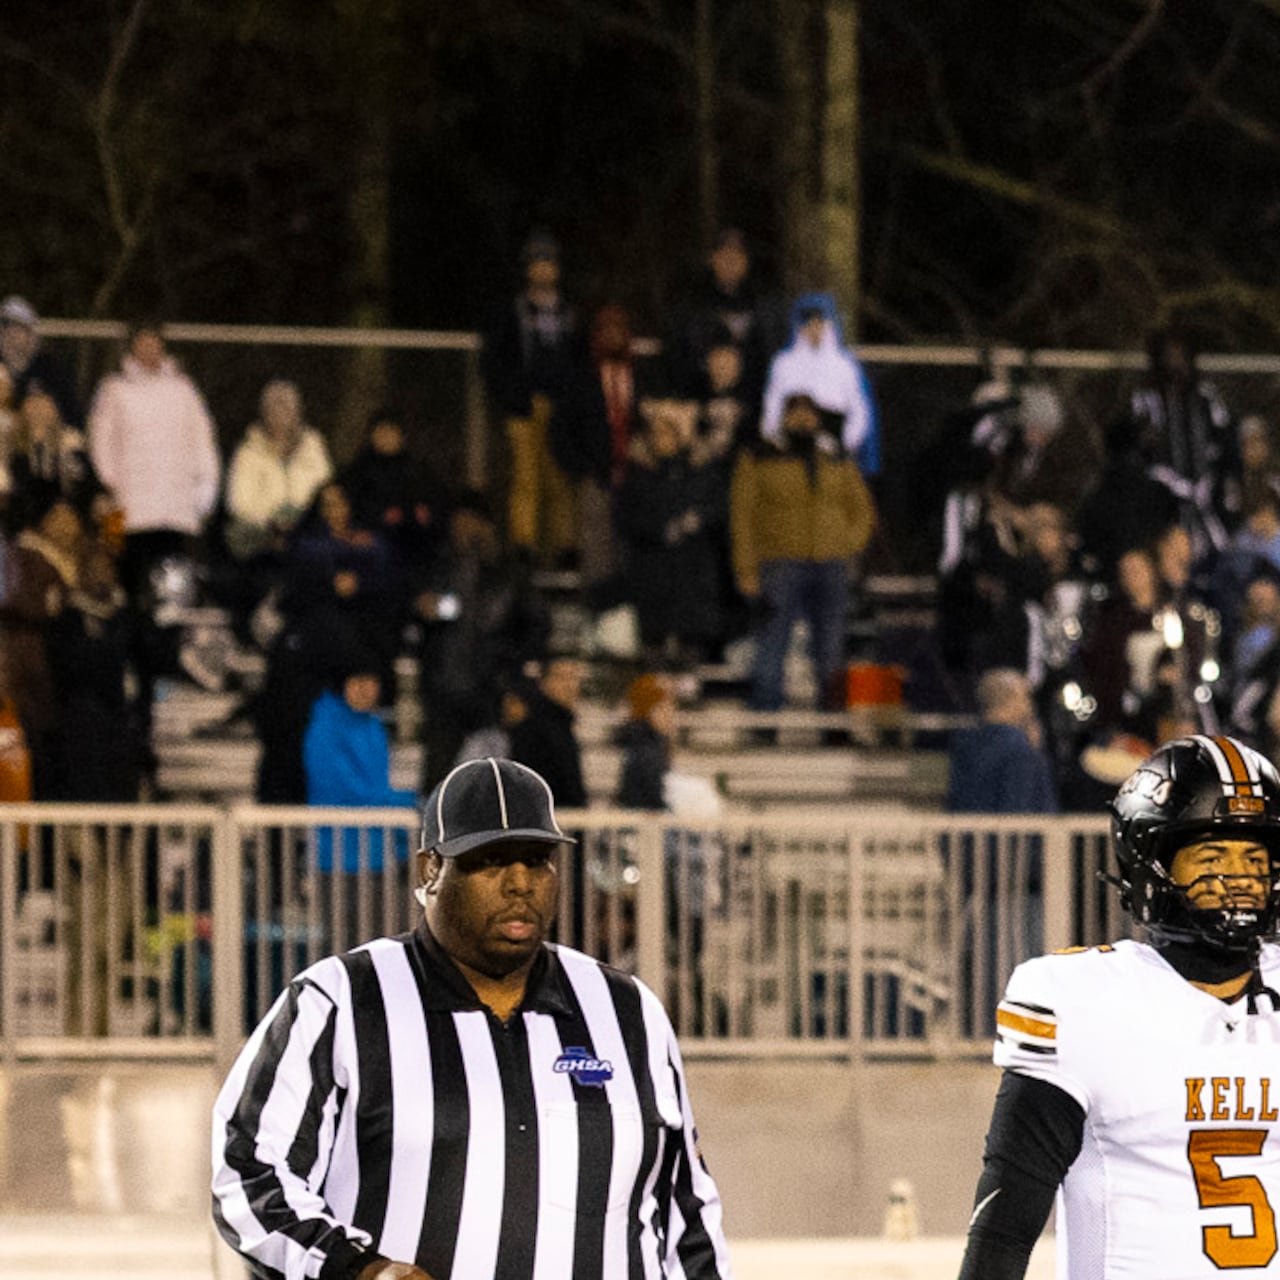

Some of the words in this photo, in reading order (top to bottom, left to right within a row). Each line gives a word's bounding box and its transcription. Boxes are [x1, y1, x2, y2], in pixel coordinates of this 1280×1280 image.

[553, 1058, 613, 1073] GHSA
[1185, 1077, 1279, 1121] KELL
[1187, 1129, 1279, 1270] 5
